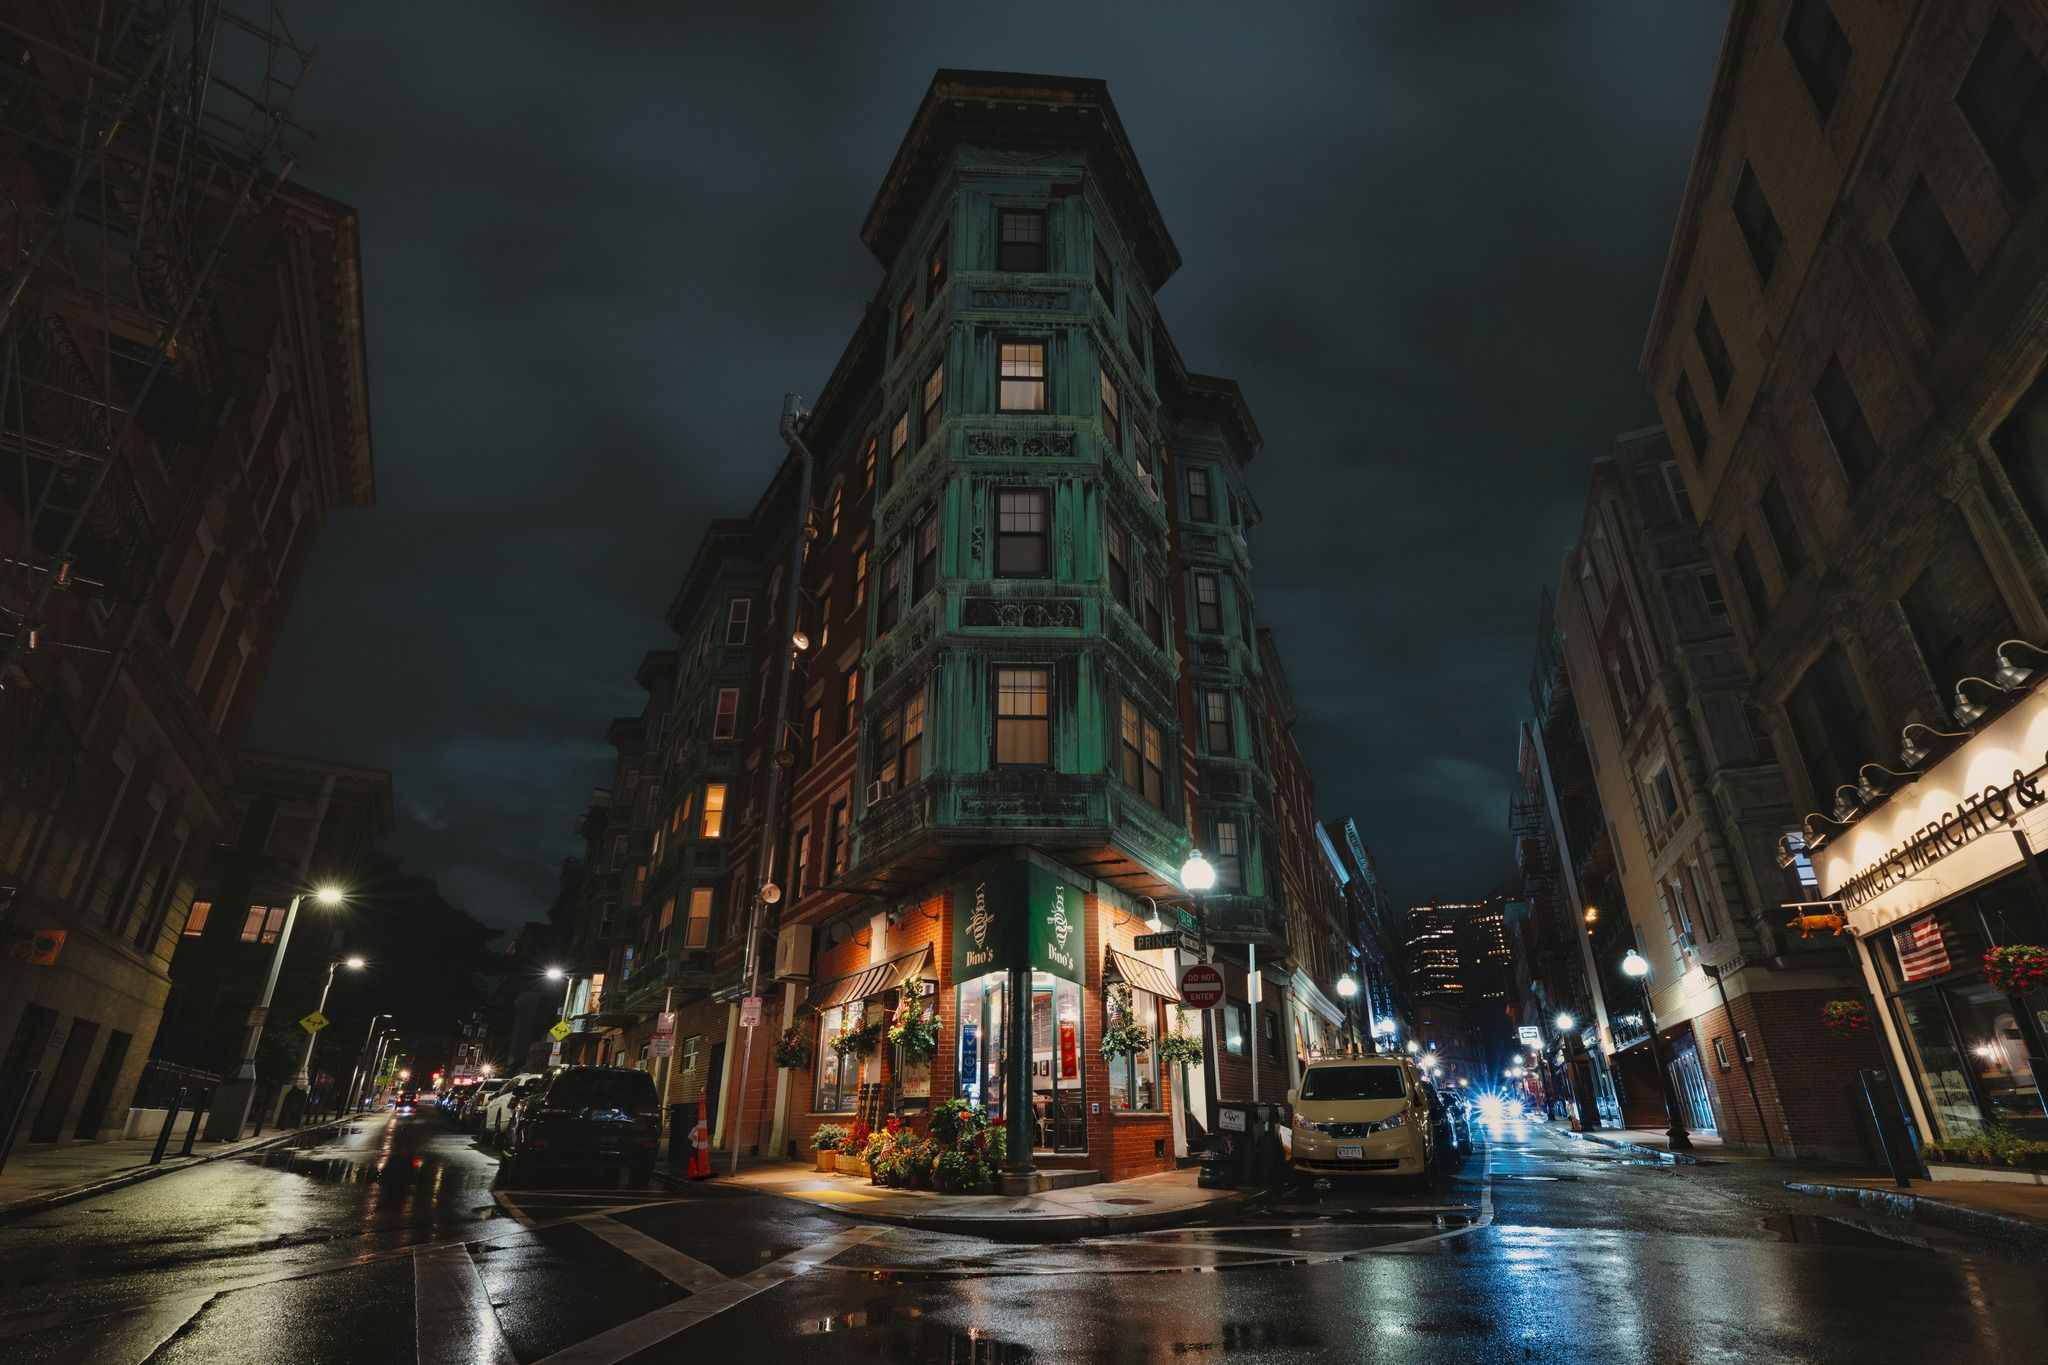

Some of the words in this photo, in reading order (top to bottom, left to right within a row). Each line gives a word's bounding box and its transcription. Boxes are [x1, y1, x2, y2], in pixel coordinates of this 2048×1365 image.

[1840, 848, 1906, 910] MONICA'S
[1903, 786, 2009, 872] MERCATO
[2014, 769, 2045, 808] &
[1138, 935, 1177, 948] PRINCE
[966, 946, 994, 968] Dino's
[1048, 943, 1074, 970] Dino's
[1370, 966, 1383, 1027] LIBERTIN
